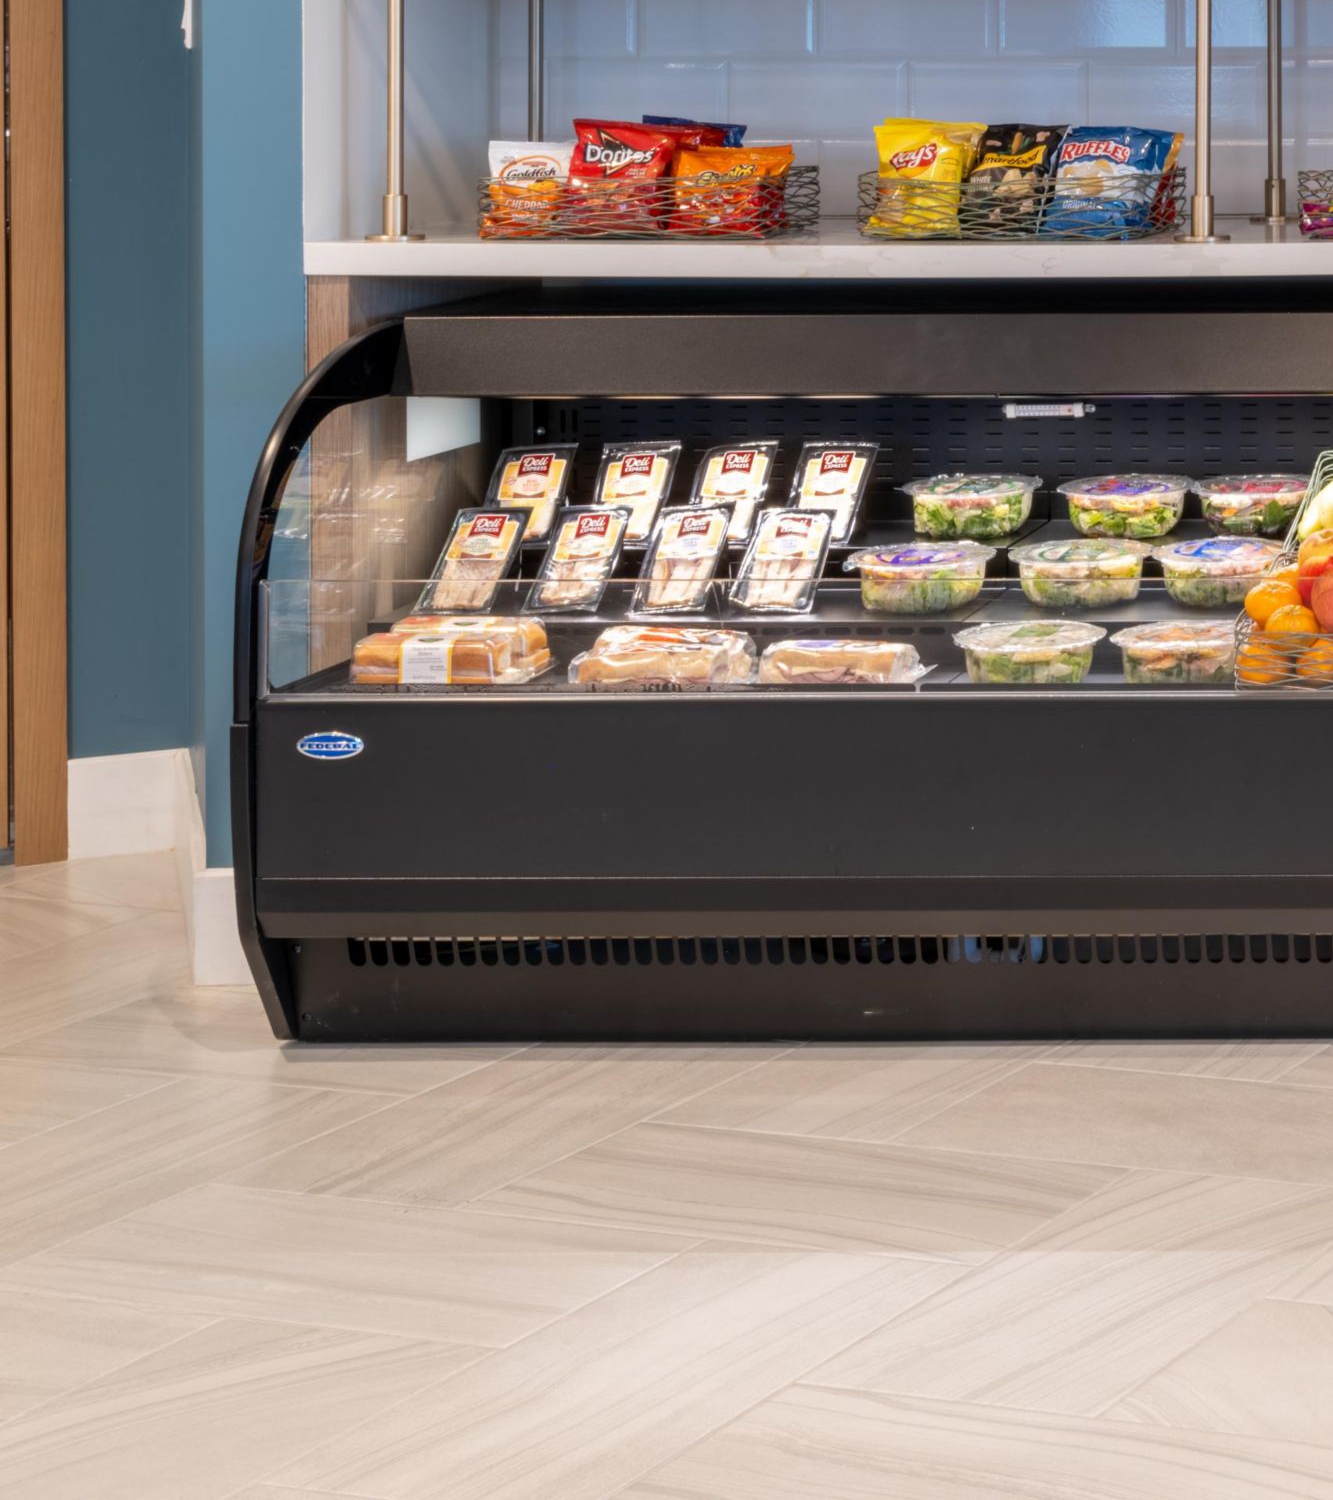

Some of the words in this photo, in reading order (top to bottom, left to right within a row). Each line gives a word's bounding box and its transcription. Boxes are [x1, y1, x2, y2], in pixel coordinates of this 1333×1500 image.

[586, 144, 655, 164] Doritos
[1062, 141, 1130, 162] RUFFLES
[506, 168, 557, 181] Goldfish
[522, 456, 549, 467] Deli
[625, 456, 652, 467] Deli
[726, 453, 751, 464] Deli
[824, 454, 849, 465] Deli
[476, 518, 502, 528] Deli
[580, 517, 606, 527] Deli
